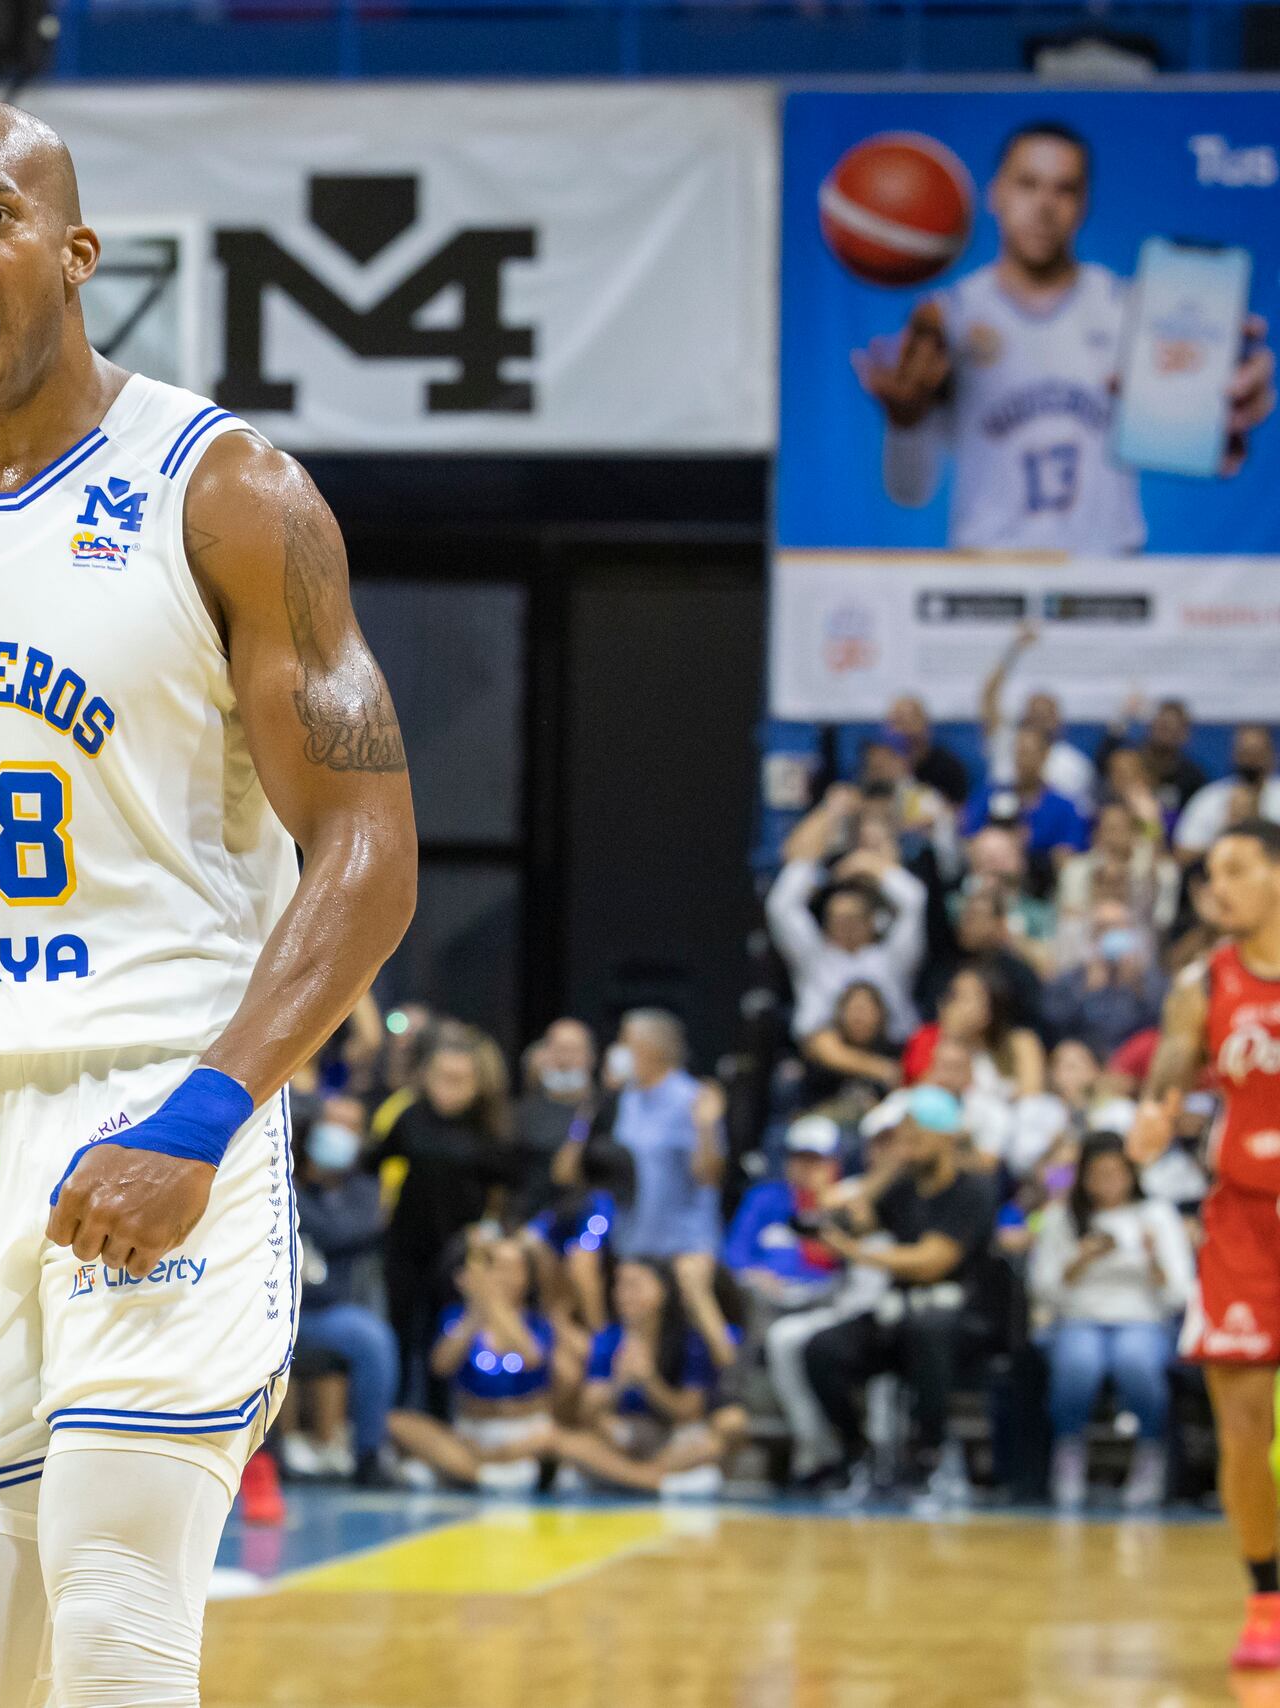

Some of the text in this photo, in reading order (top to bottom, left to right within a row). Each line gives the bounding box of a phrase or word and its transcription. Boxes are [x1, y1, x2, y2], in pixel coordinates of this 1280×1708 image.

[1189, 134, 1278, 187] Tus
[1023, 444, 1080, 513] 13
[76, 537, 130, 567] BSN
